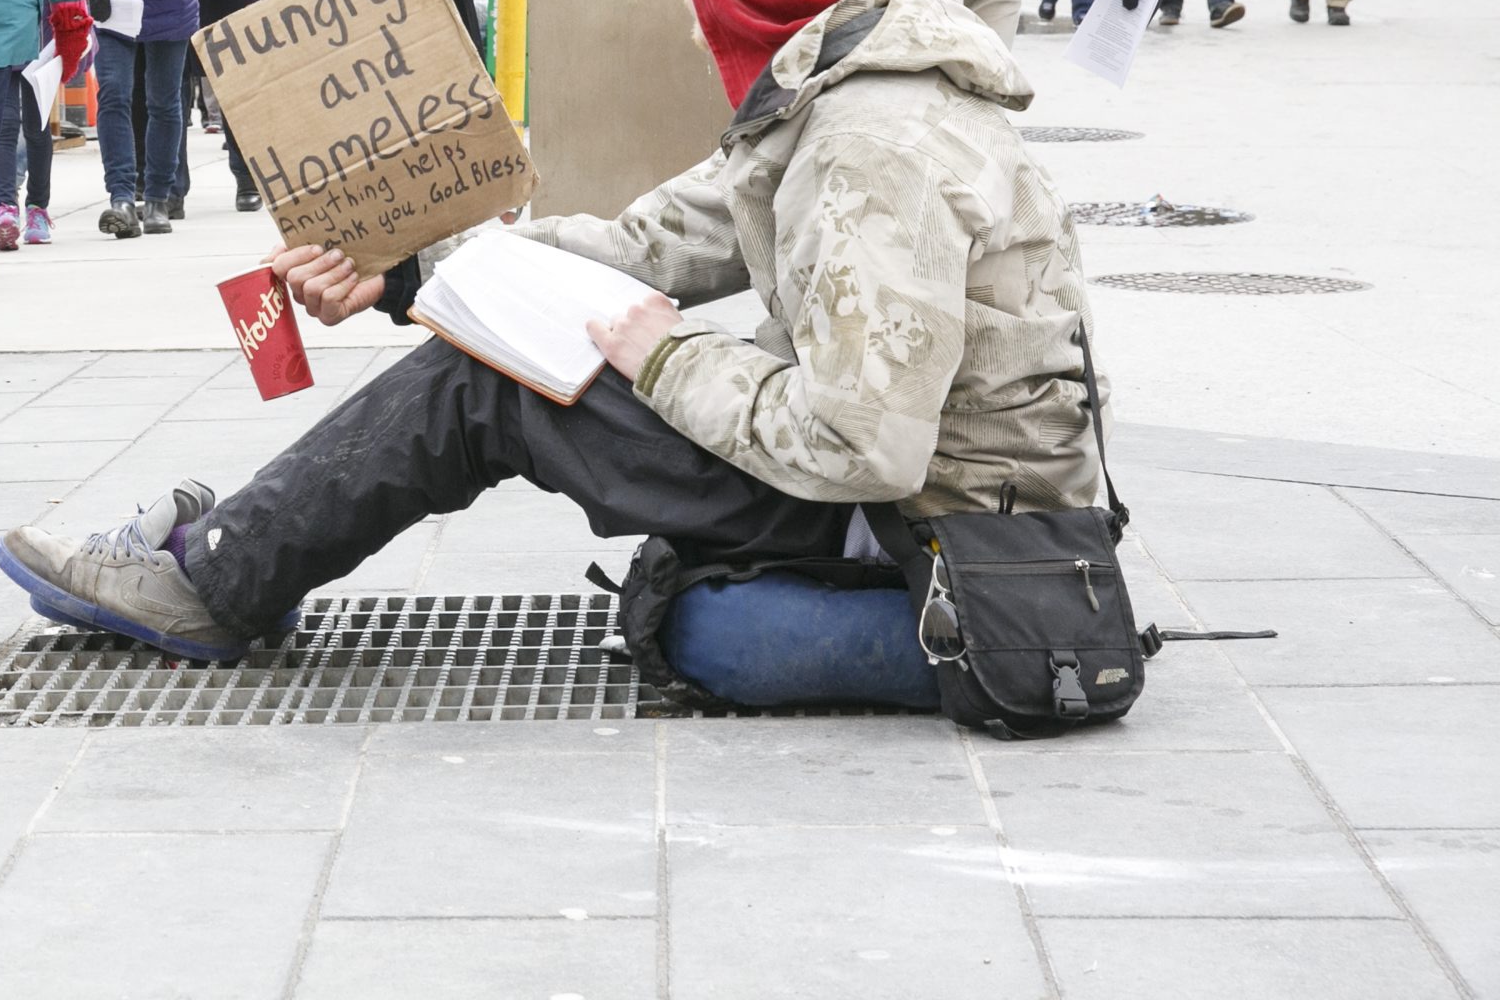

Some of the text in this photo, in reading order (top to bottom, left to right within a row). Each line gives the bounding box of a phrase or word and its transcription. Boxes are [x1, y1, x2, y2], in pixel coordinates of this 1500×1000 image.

[319, 24, 414, 110] and
[249, 74, 494, 213] Homeless
[278, 139, 466, 239] Anything helps
[307, 218, 369, 251] ank
[429, 174, 470, 203] God
[470, 154, 527, 187] Bless
